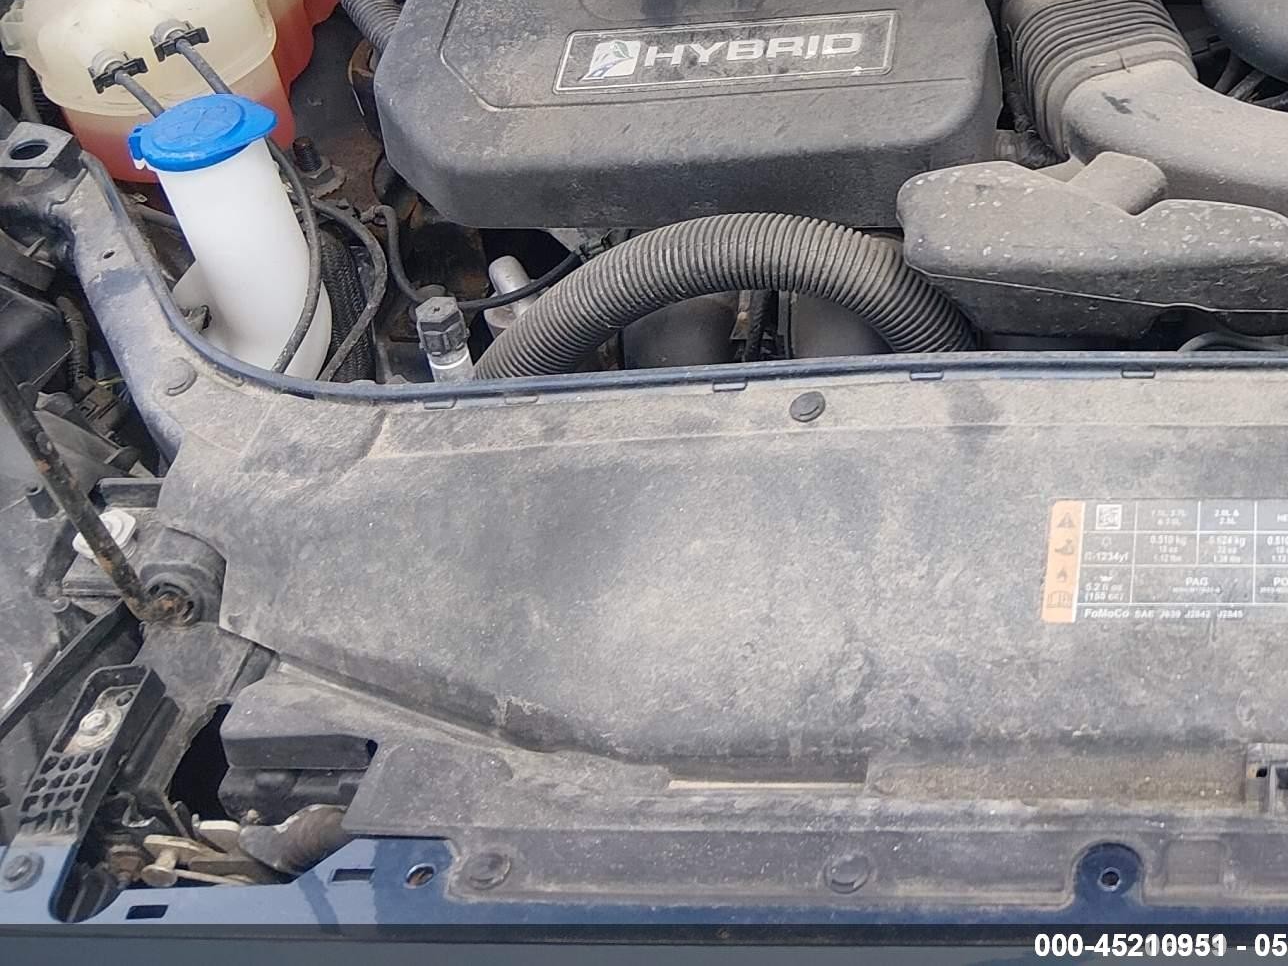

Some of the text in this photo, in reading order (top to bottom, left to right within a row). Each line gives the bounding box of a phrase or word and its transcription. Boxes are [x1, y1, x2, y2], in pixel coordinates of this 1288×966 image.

[644, 33, 863, 67] HYBRID
[1185, 576, 1209, 587] PAG
[1083, 608, 1131, 619] FoMoCo
